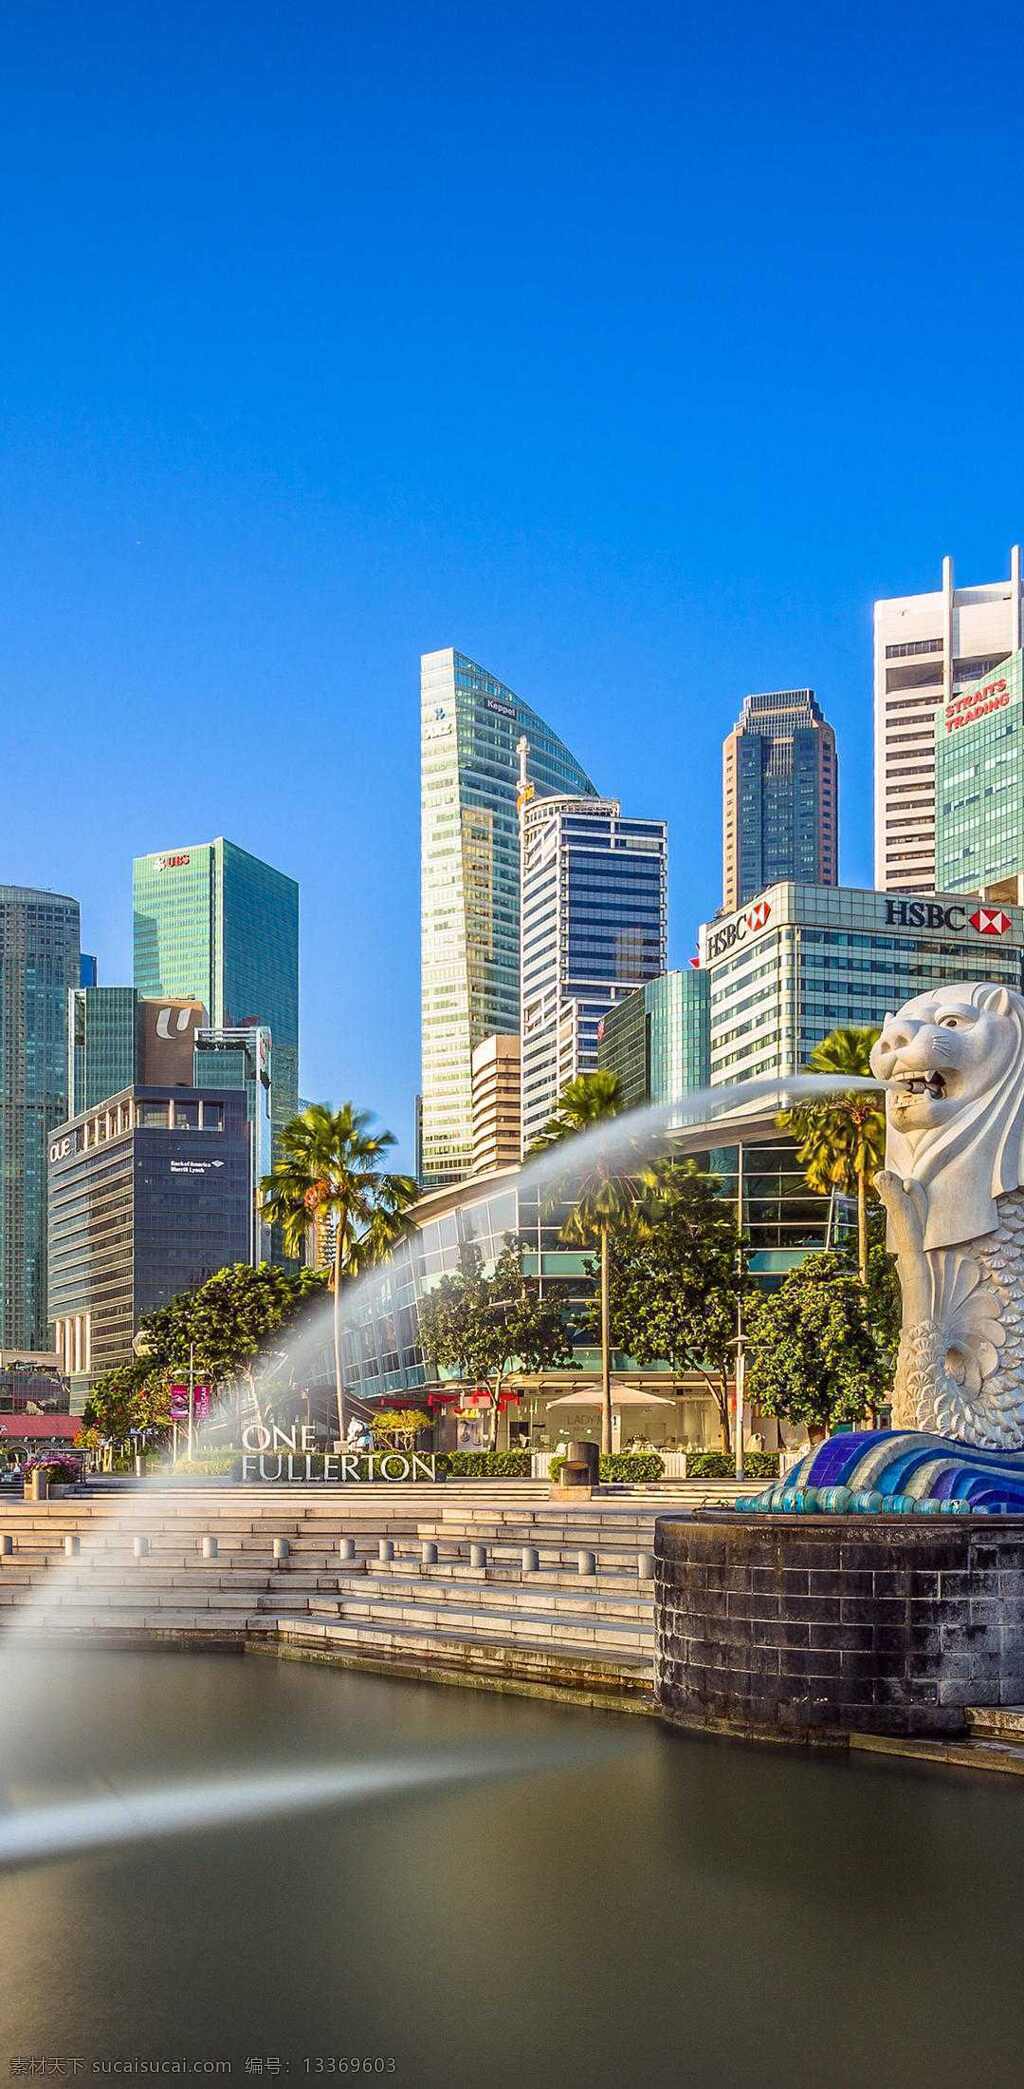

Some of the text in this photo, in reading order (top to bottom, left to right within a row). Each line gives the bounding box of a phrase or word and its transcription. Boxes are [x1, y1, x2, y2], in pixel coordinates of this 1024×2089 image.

[487, 700, 516, 717] Keppel
[945, 678, 1007, 718] STRAITS
[945, 693, 1010, 733] TRADING
[168, 854, 190, 868] UBS
[885, 899, 967, 931] HSBC
[706, 914, 747, 961] HSBC
[242, 1424, 317, 1453] ONE
[242, 1454, 436, 1482] FULLERTON
